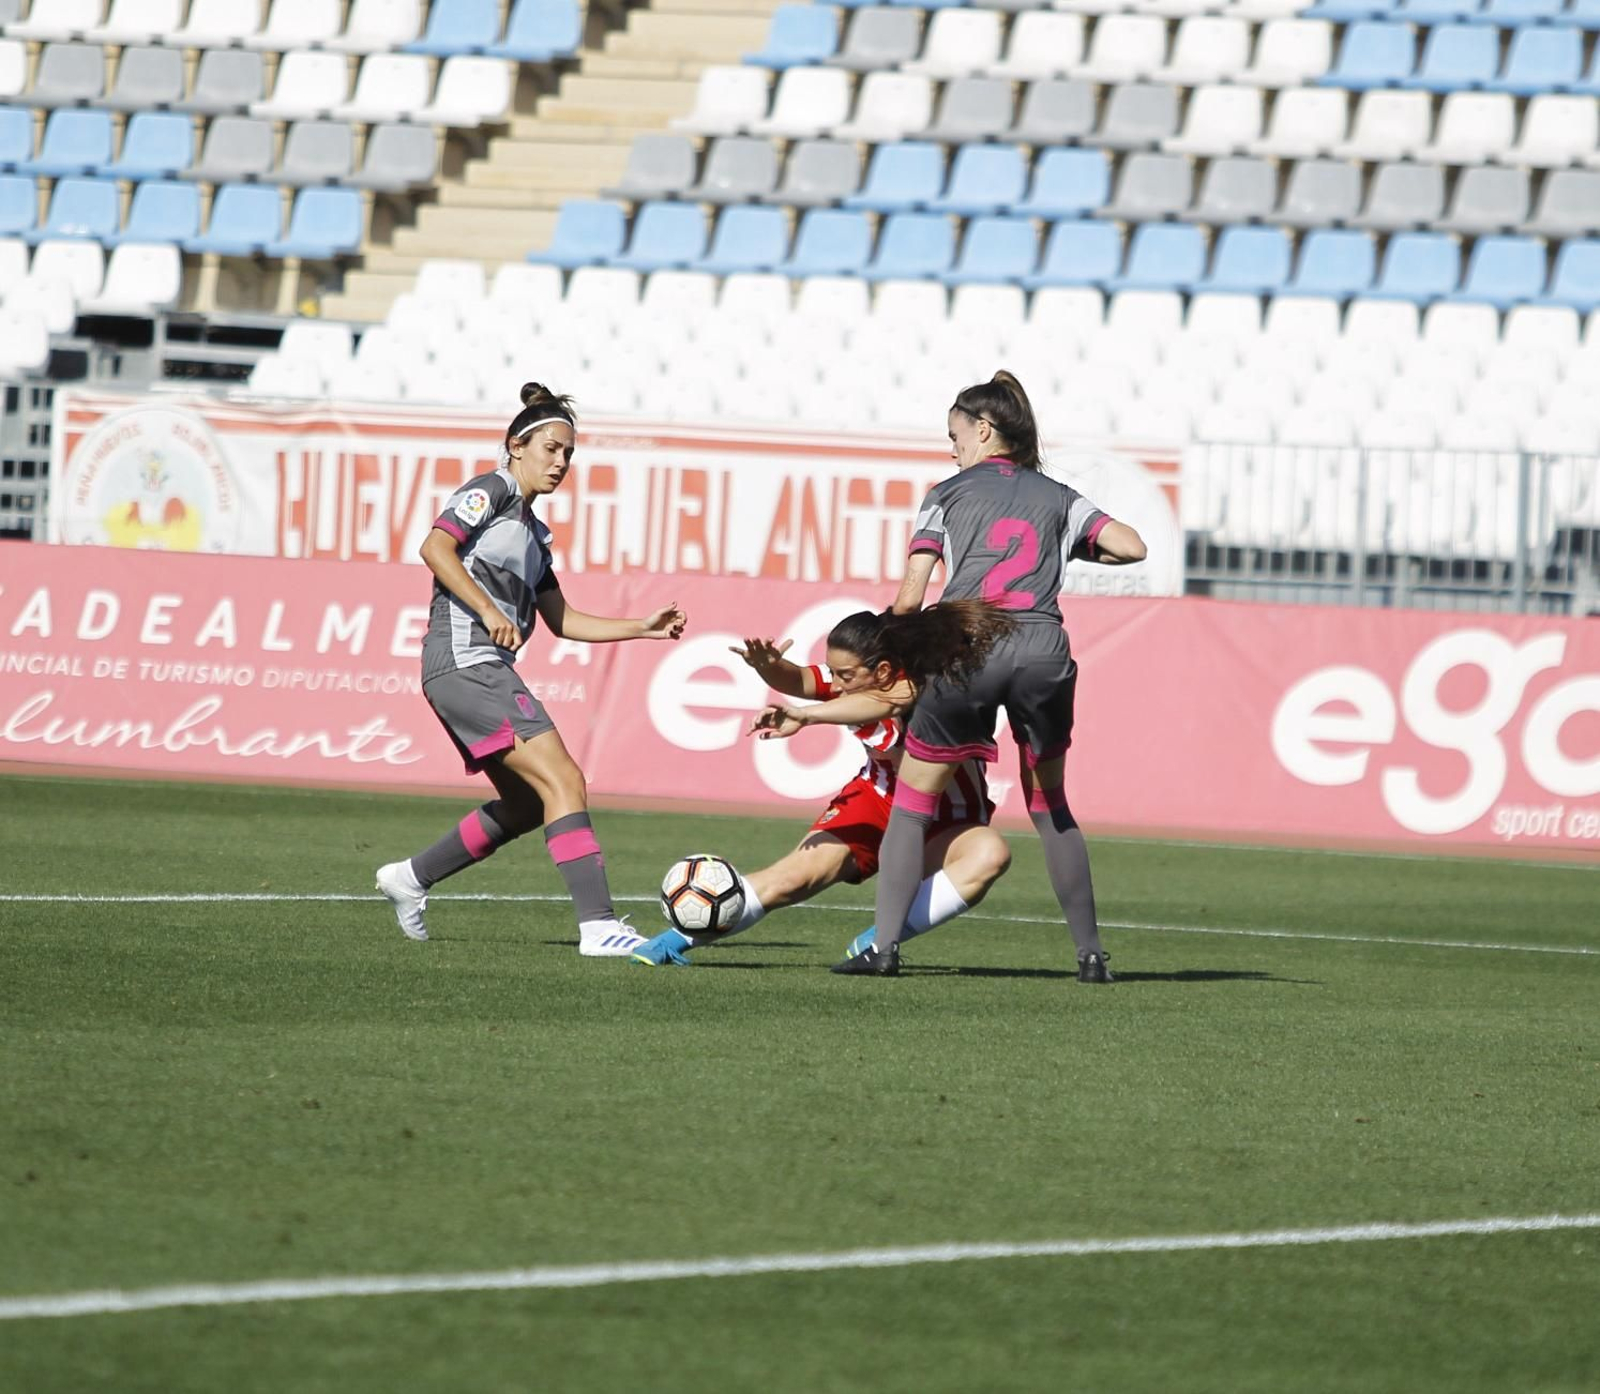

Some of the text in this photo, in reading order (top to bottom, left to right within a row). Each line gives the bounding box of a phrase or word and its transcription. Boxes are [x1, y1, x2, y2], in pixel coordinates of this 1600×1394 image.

[546, 464, 947, 582] ROJIBLANCO
[980, 516, 1040, 610] 2
[93, 657, 129, 680] DE
[140, 661, 255, 687] TURISMO
[1273, 629, 1600, 834] ego
[1493, 805, 1563, 840] sport
